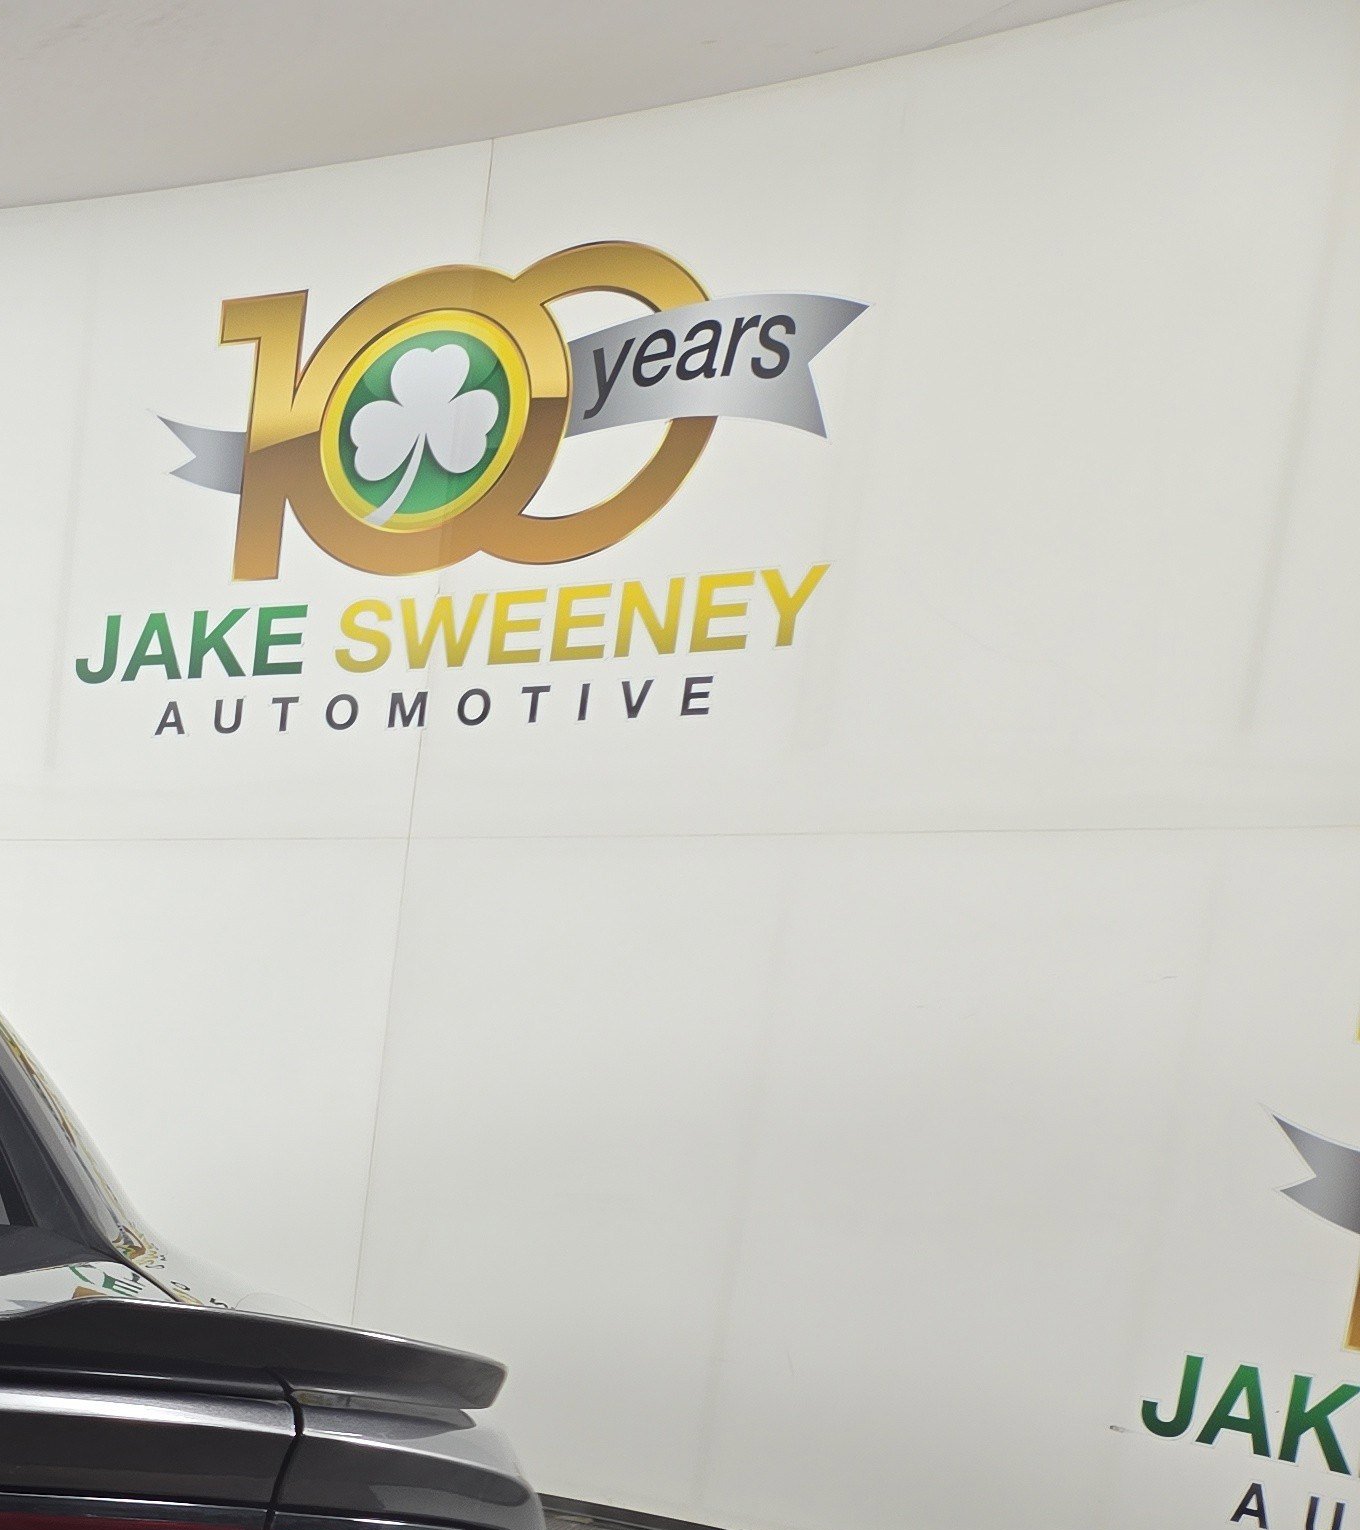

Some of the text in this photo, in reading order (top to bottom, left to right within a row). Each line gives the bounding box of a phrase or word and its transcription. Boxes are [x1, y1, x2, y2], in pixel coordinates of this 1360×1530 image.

[220, 240, 797, 582] 100 years
[75, 563, 831, 685] JAKE SWEENEY
[155, 675, 715, 737] AUTOMOTIVE
